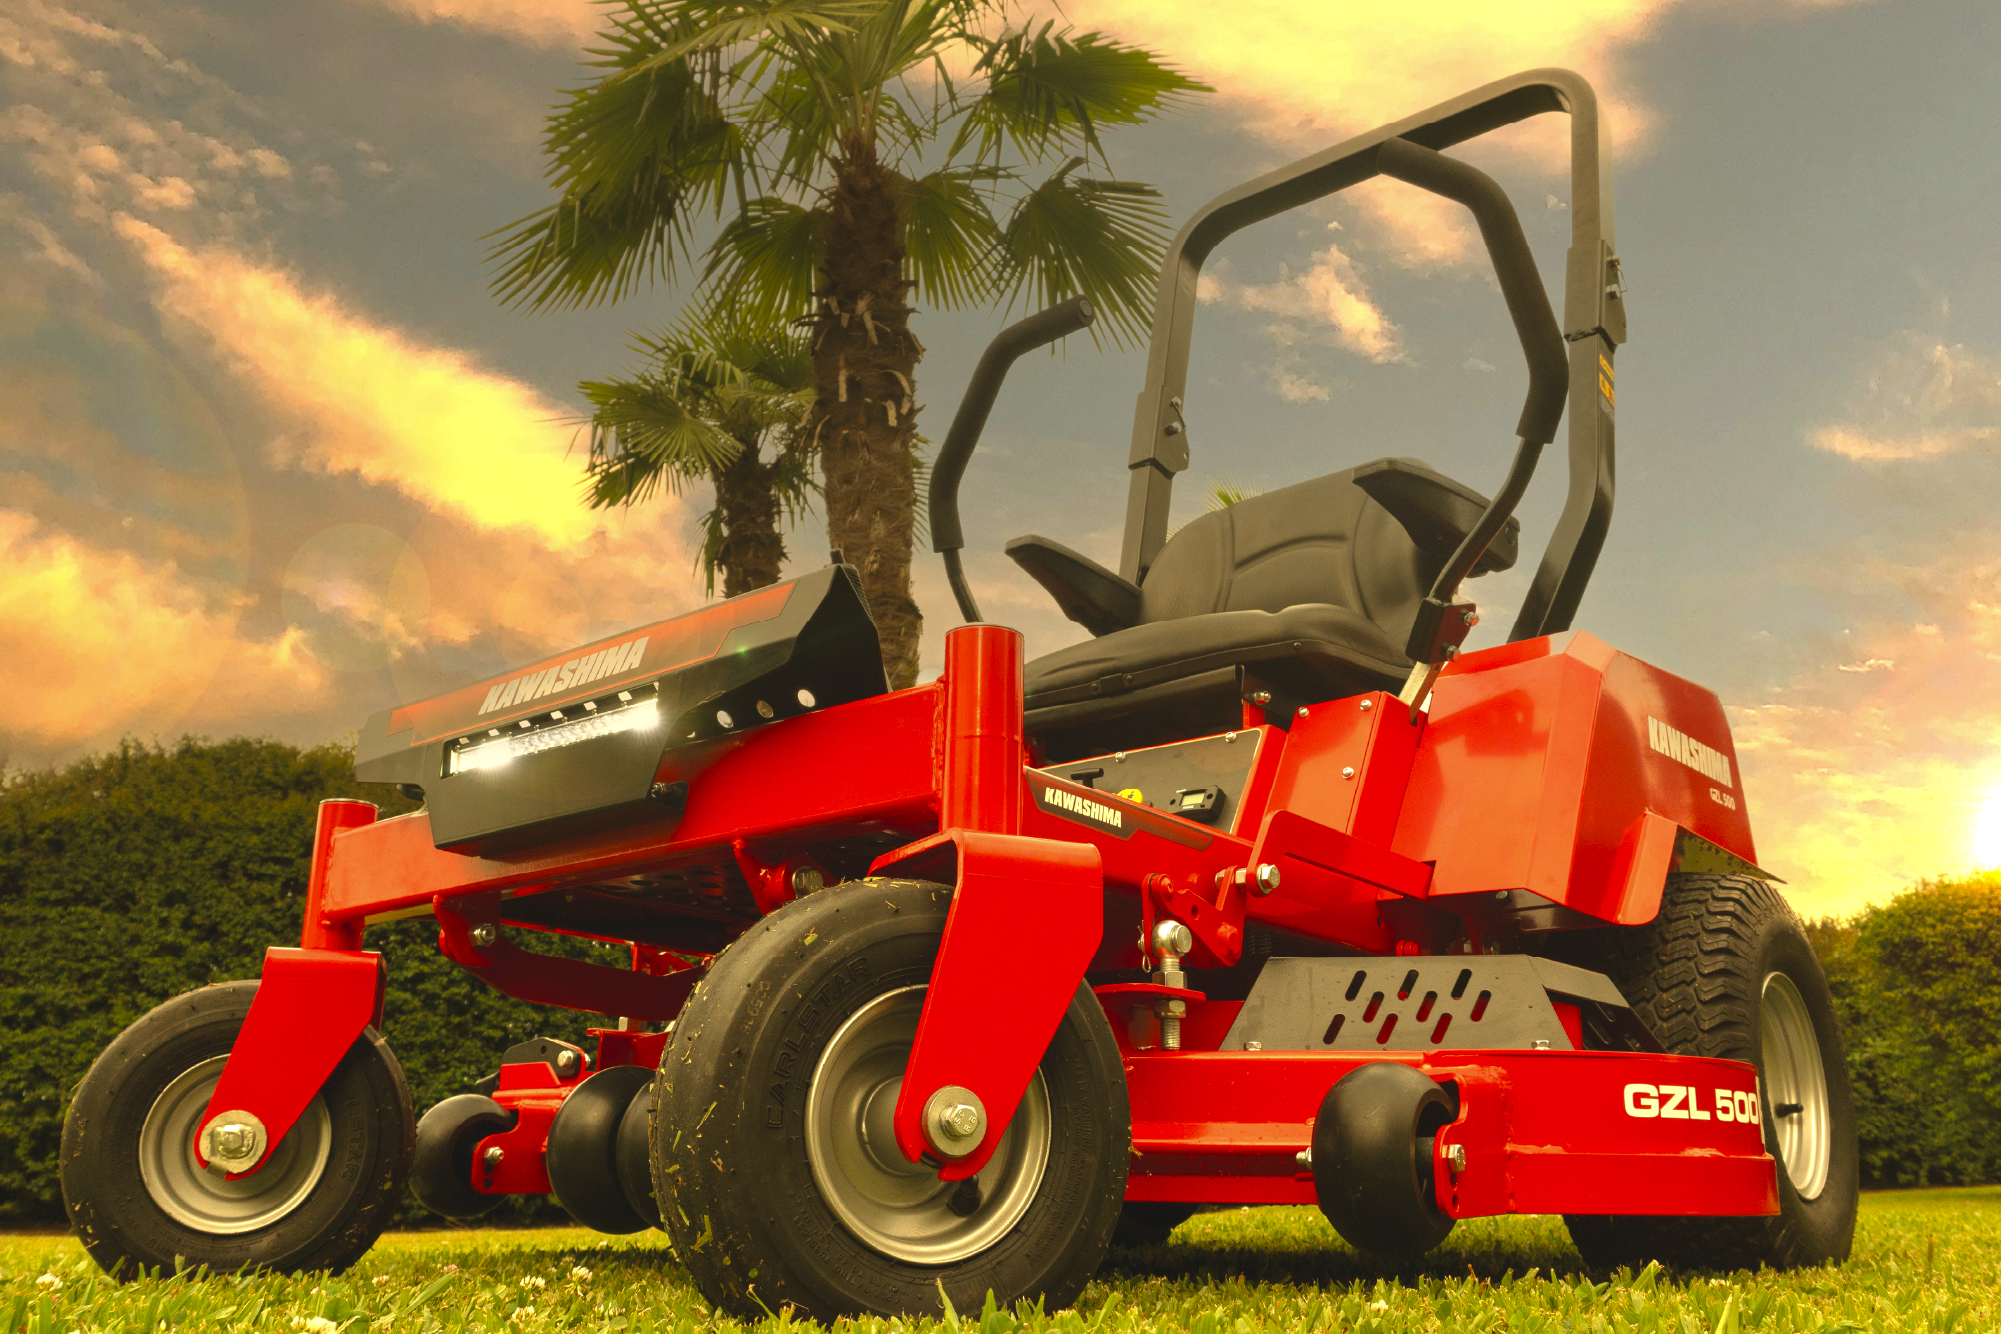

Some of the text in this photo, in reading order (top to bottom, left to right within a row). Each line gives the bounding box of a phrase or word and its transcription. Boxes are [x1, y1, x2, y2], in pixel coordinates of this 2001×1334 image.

[477, 635, 650, 716] KAWASHIMA
[1648, 715, 1733, 789] KAWASHIMA
[1044, 786, 1122, 828] KAWASHIMA
[1722, 793, 1736, 811] 500
[766, 957, 870, 1128] CARLSTAR
[1069, 1051, 1088, 1094] SAFETY
[1624, 1083, 1759, 1125] GZL 500
